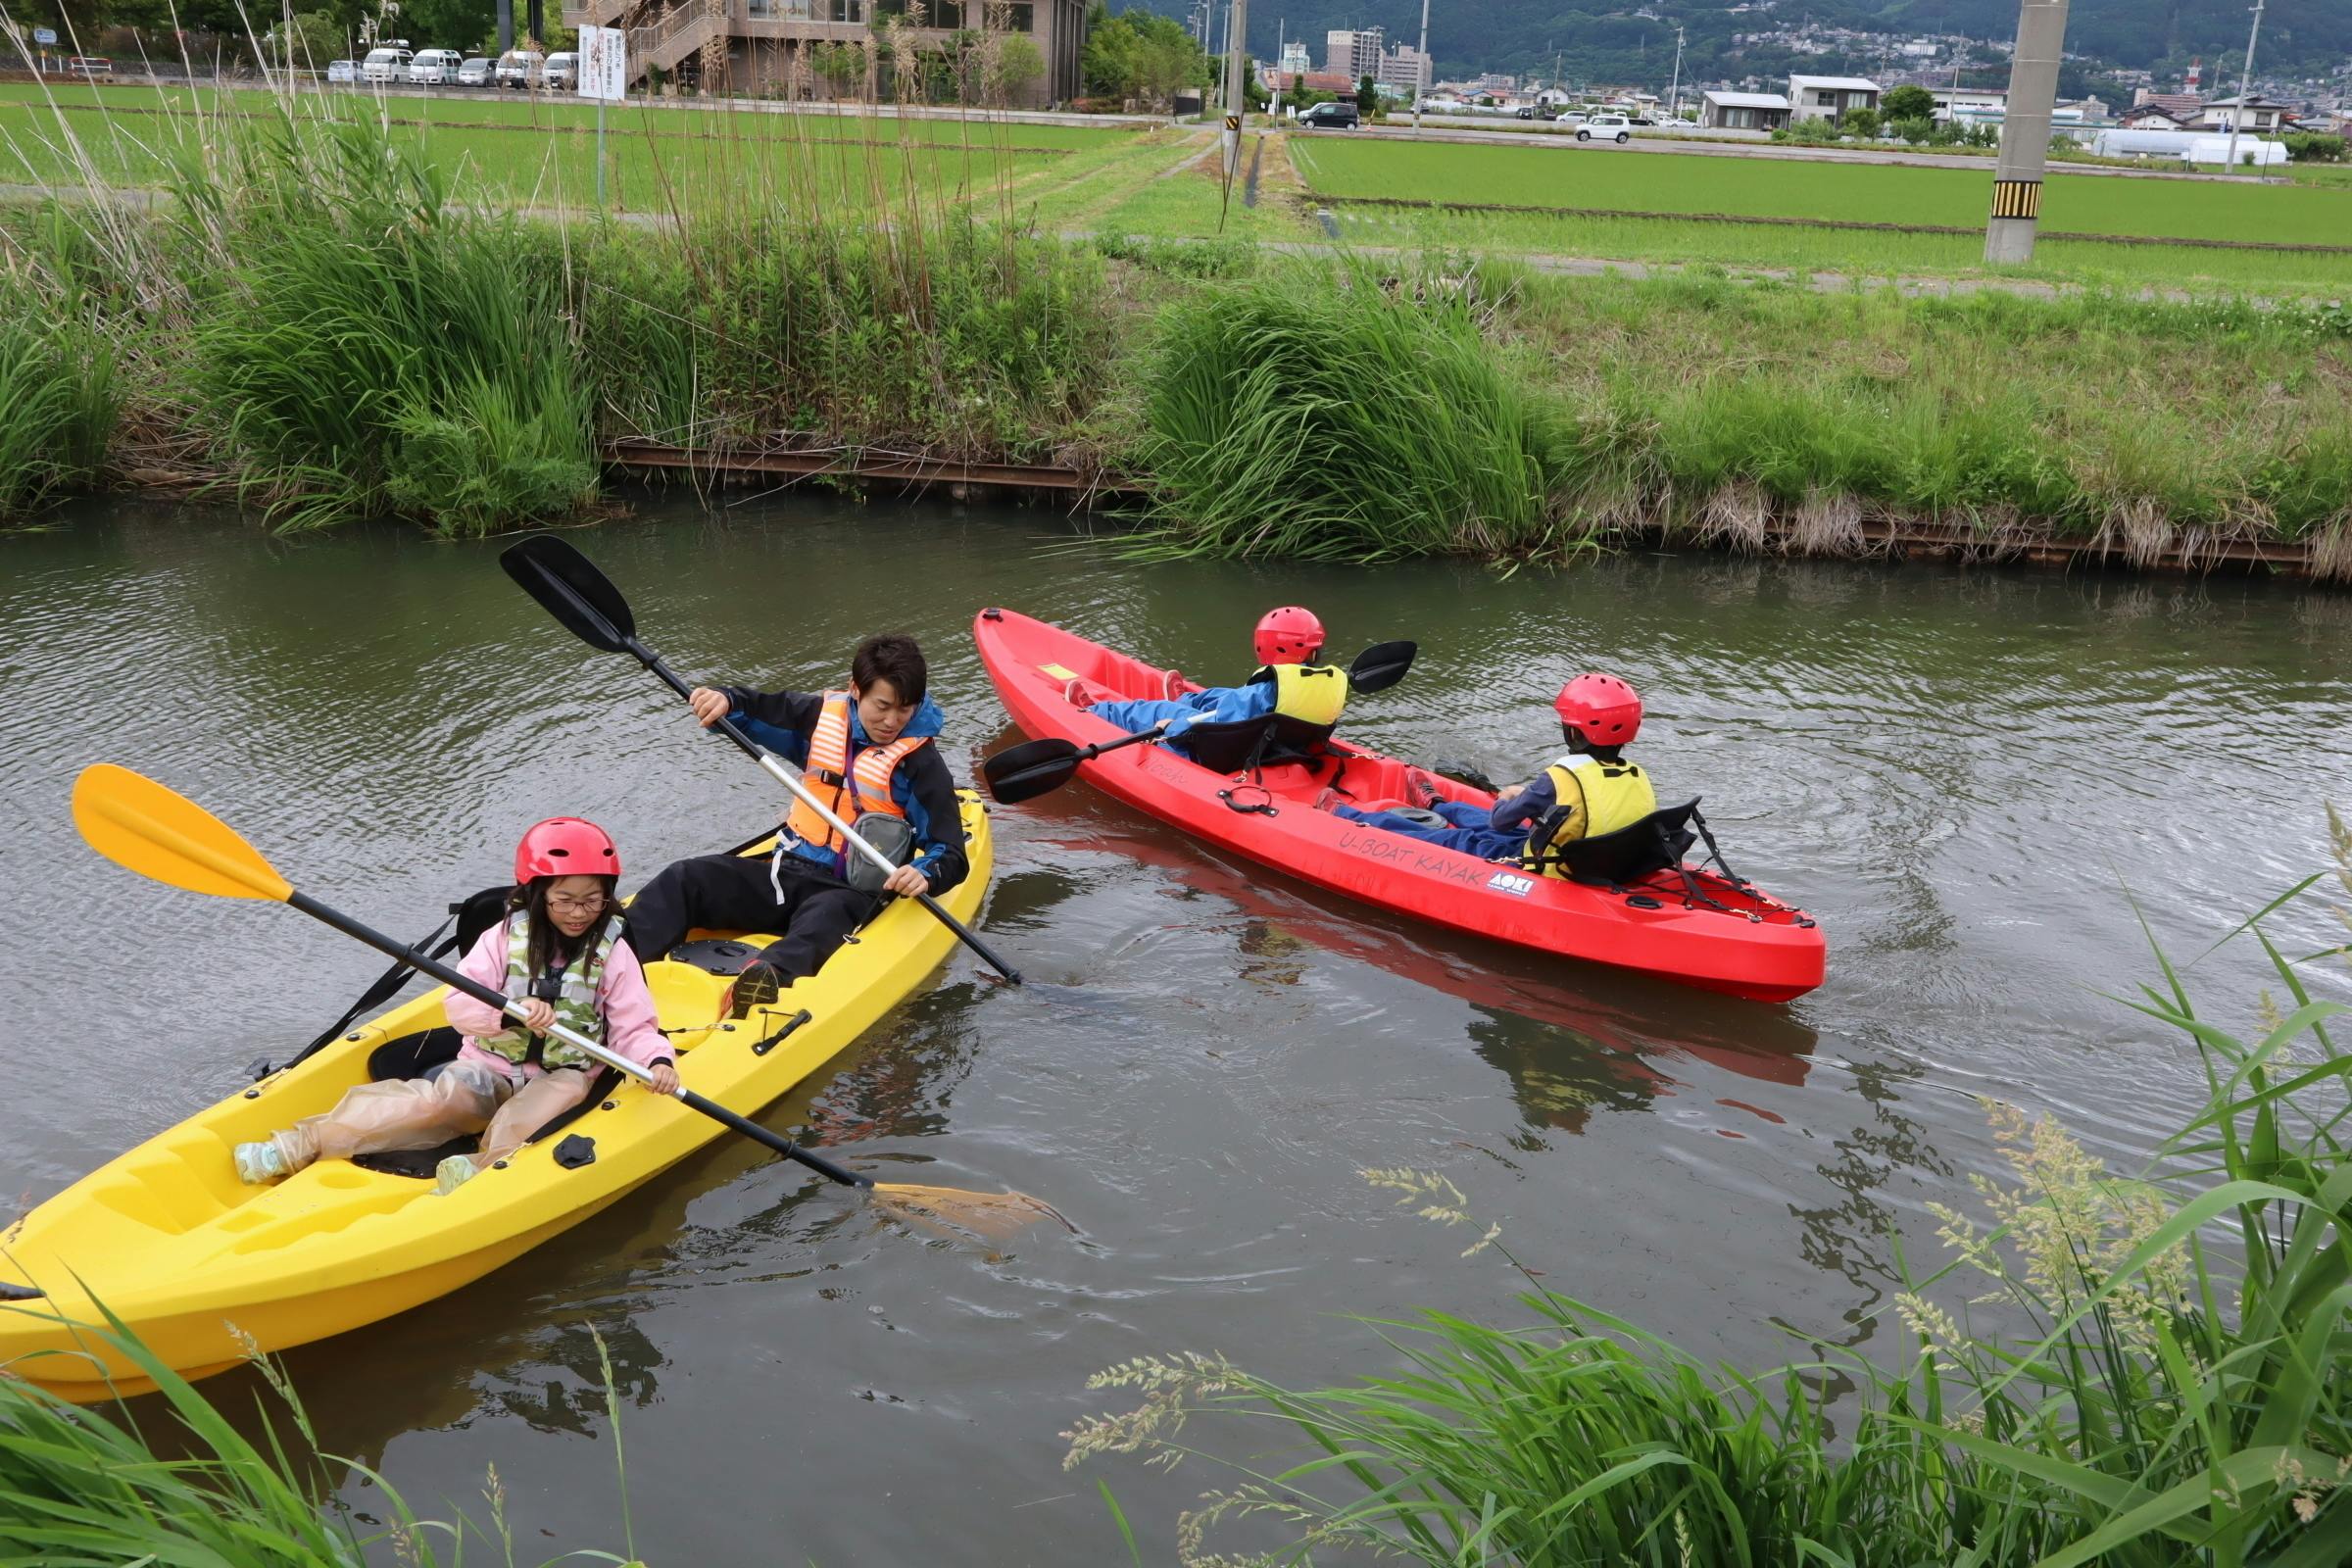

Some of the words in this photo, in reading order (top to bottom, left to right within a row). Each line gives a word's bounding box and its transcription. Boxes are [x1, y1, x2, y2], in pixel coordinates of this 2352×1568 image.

[1339, 832, 1414, 862] U-BOAT
[1414, 855, 1486, 885] KAYAK
[1489, 872, 1535, 893] AOKI
